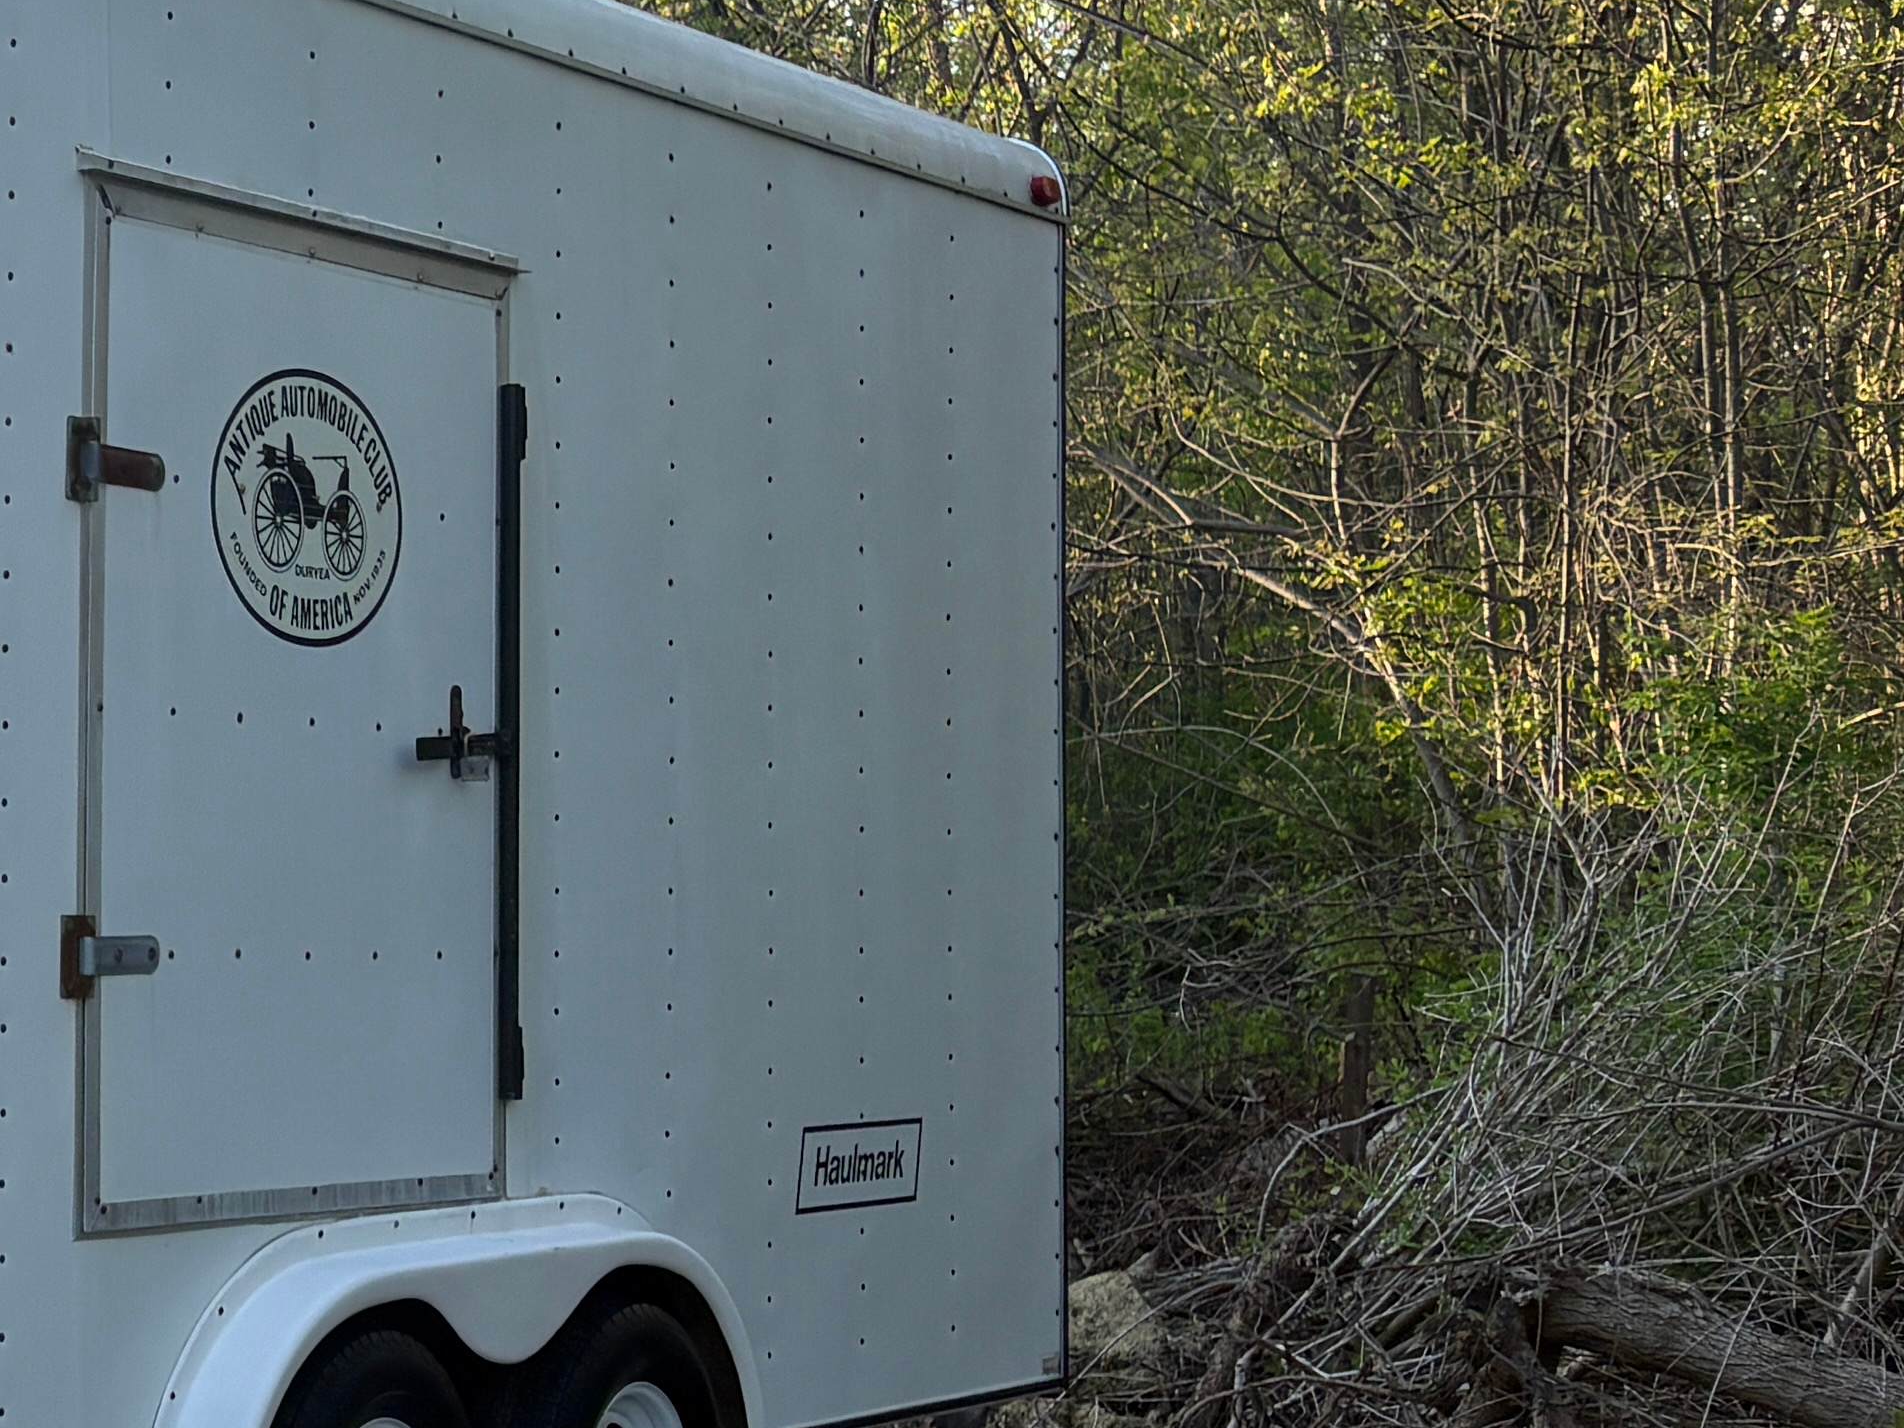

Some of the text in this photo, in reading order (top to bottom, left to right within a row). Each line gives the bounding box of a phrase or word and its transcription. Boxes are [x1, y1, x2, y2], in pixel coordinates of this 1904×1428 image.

[224, 385, 392, 505] ANTIQUE AUTOMOBILE CLUB
[229, 531, 268, 597] FOUNDED
[269, 584, 354, 631] OF AMERICA
[814, 1139, 905, 1187] Haulmark
